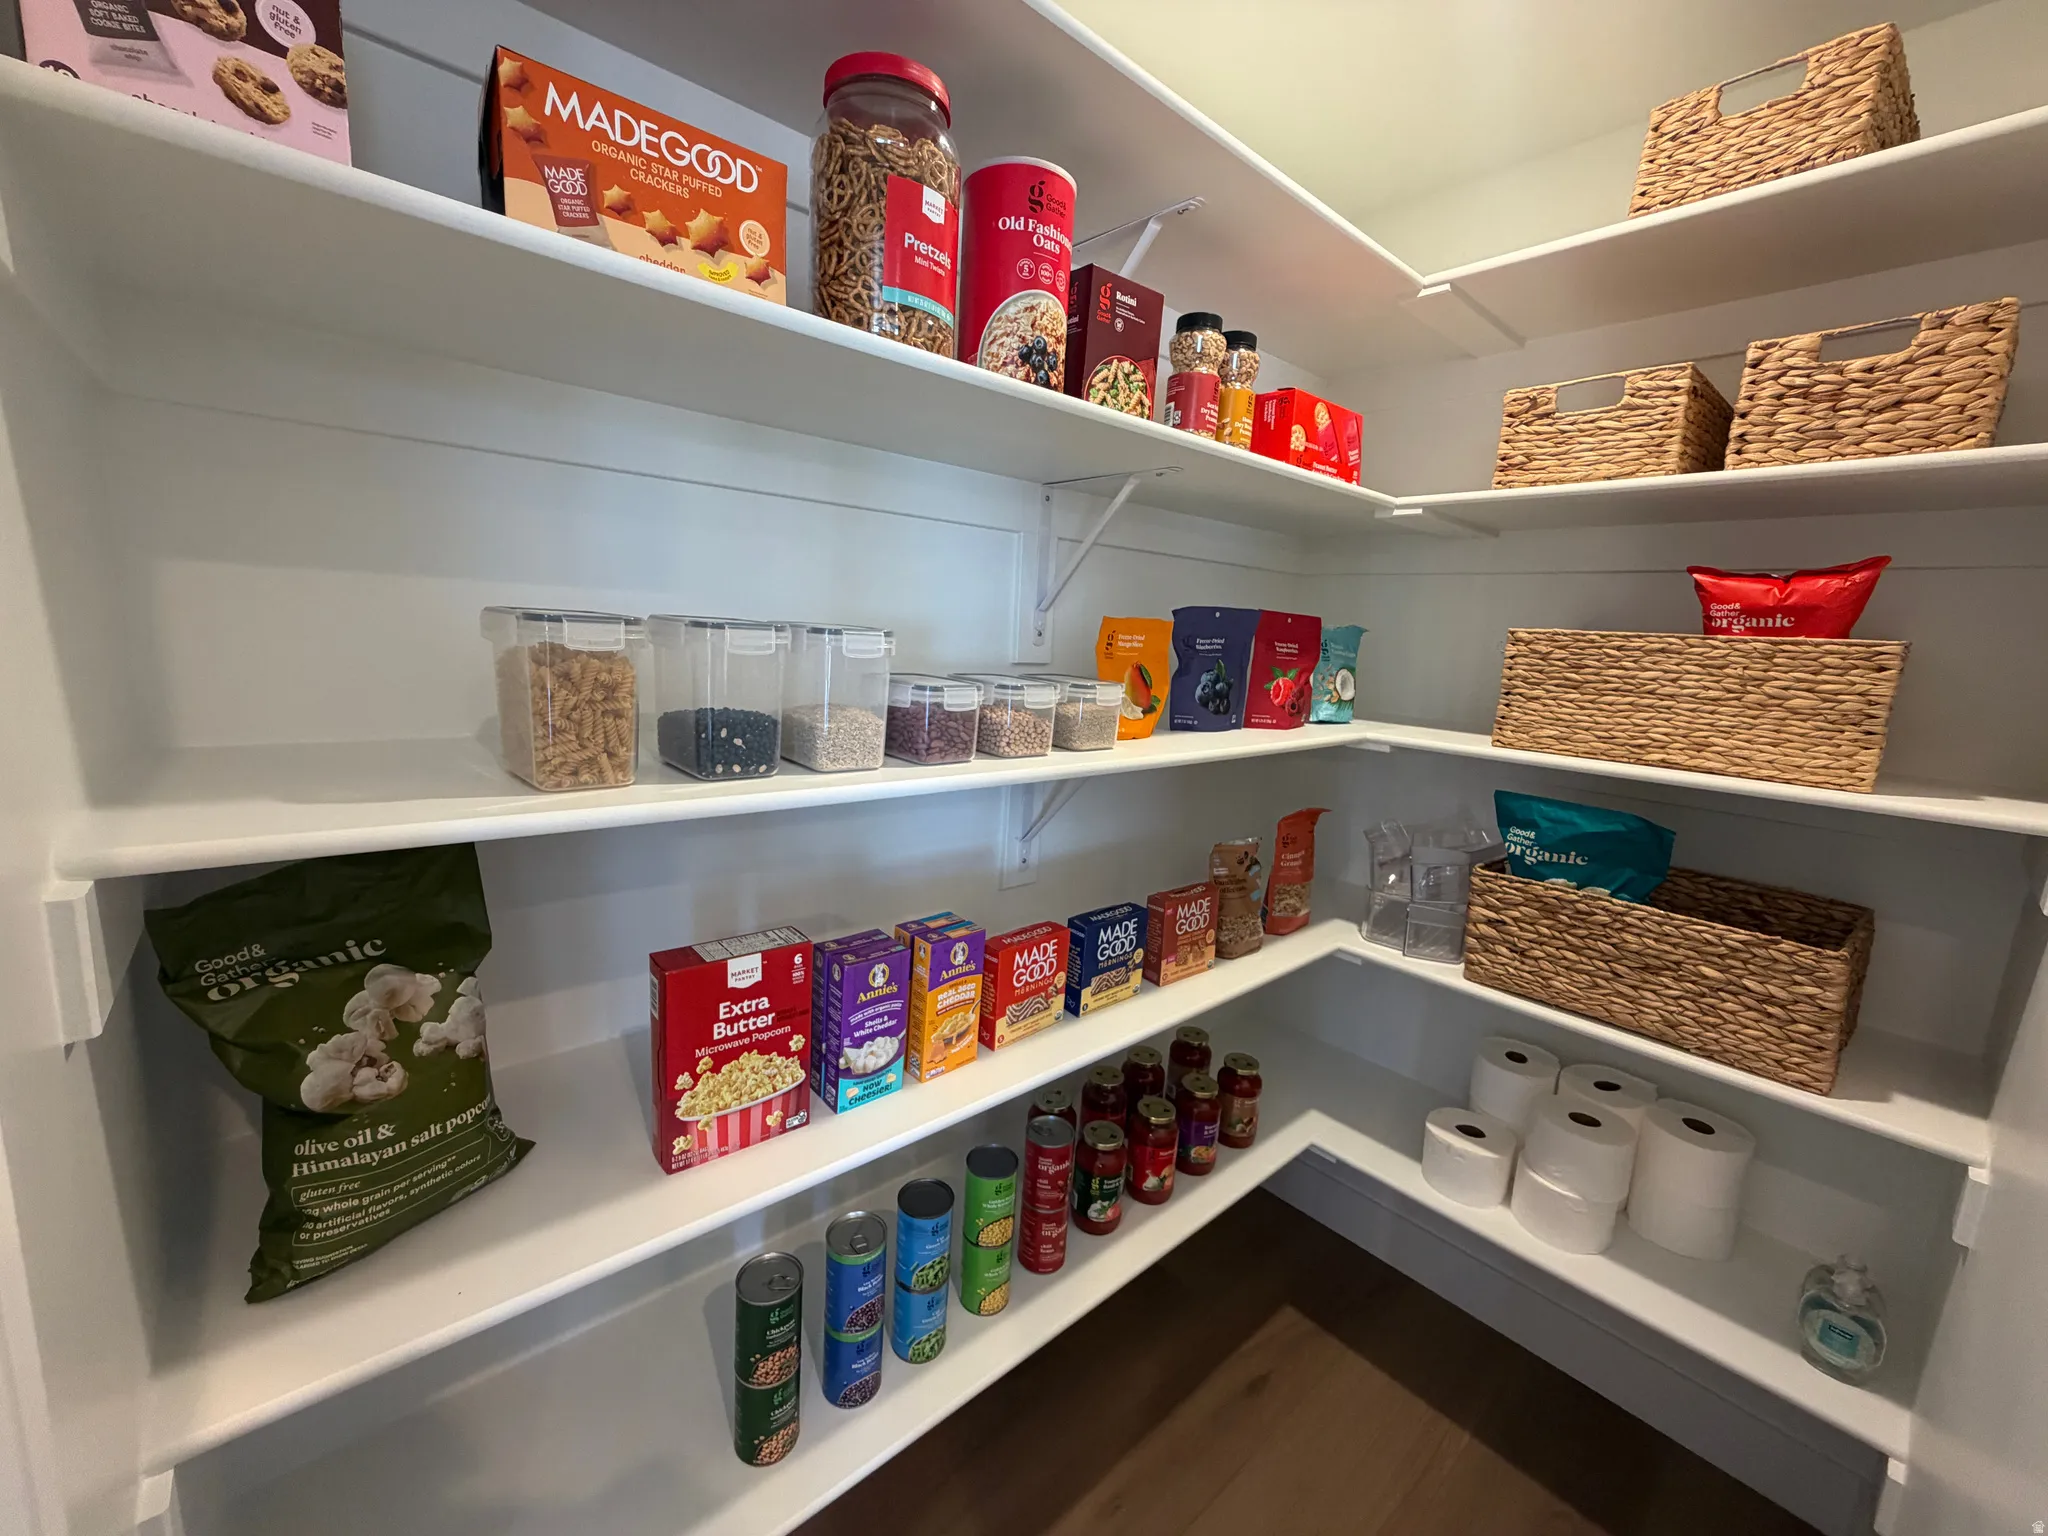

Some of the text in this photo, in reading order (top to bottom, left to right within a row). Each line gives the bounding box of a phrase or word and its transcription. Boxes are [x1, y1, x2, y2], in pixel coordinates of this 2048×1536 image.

[88, 8, 139, 23] SOFT BAKED
[91, 0, 130, 13] ORGANIC
[272, 5, 301, 25] nut &
[90, 17, 146, 33] COOKIE BITES
[269, 12, 302, 34] gluten
[274, 22, 296, 39] free
[544, 165, 586, 182] MADE
[591, 140, 722, 198] ORGANIC STAR PUFFED
[548, 178, 588, 196] GOOD
[630, 168, 690, 199] CRACKERS
[560, 198, 584, 206] ORGANIC
[571, 205, 590, 213] PUFFED
[925, 199, 944, 215] MARKET
[1046, 193, 1066, 211] Good&
[1046, 203, 1066, 219] Gather
[562, 211, 590, 219] CRACKERS
[998, 215, 1025, 230] Old
[904, 231, 951, 270] Pretzels
[1033, 233, 1061, 255] Oats
[914, 255, 929, 267] Mini
[1023, 264, 1029, 273] 5
[1116, 290, 1137, 307] Rotini
[1709, 609, 1740, 617] Gather
[1710, 602, 1741, 610] Good&
[1711, 613, 1795, 633] organic
[1506, 833, 1534, 847] Gather
[1509, 825, 1536, 839] Good&
[1504, 841, 1589, 866] organic
[1176, 897, 1211, 920] MADE
[1098, 918, 1138, 945] MADE
[1176, 913, 1210, 935] GOOD
[194, 943, 267, 973] Good&
[1013, 938, 1058, 970] MADE
[1097, 935, 1136, 961] GOOD
[794, 953, 803, 965] 6
[200, 958, 271, 986] Gather
[207, 938, 387, 1001] organic
[731, 966, 759, 979] MARKET
[734, 974, 755, 982] PANTRY
[940, 960, 976, 982] Annie's
[1013, 957, 1057, 988] GOOD
[856, 982, 899, 1005] Annie's
[719, 996, 771, 1020] Extra
[713, 1012, 776, 1040] Butter
[853, 1019, 898, 1038] White Cheddar
[864, 1017, 883, 1028] Shells
[695, 1025, 792, 1058] Microwave Popcorn
[862, 1079, 882, 1092] NOW
[291, 1141, 408, 1178] Himalayan
[410, 1122, 444, 1148] salt
[446, 1092, 491, 1134] popco
[294, 1122, 397, 1156] olive oil &
[299, 1181, 361, 1202] gluten free
[316, 1211, 366, 1230] artificial
[368, 1194, 408, 1214] flavors,
[410, 1169, 453, 1196] synthetic
[455, 1154, 481, 1172] colors
[323, 1198, 360, 1214] whole
[362, 1189, 391, 1205] grain
[393, 1180, 411, 1193] per
[300, 1232, 311, 1240] or
[313, 1208, 391, 1241] preservatives
